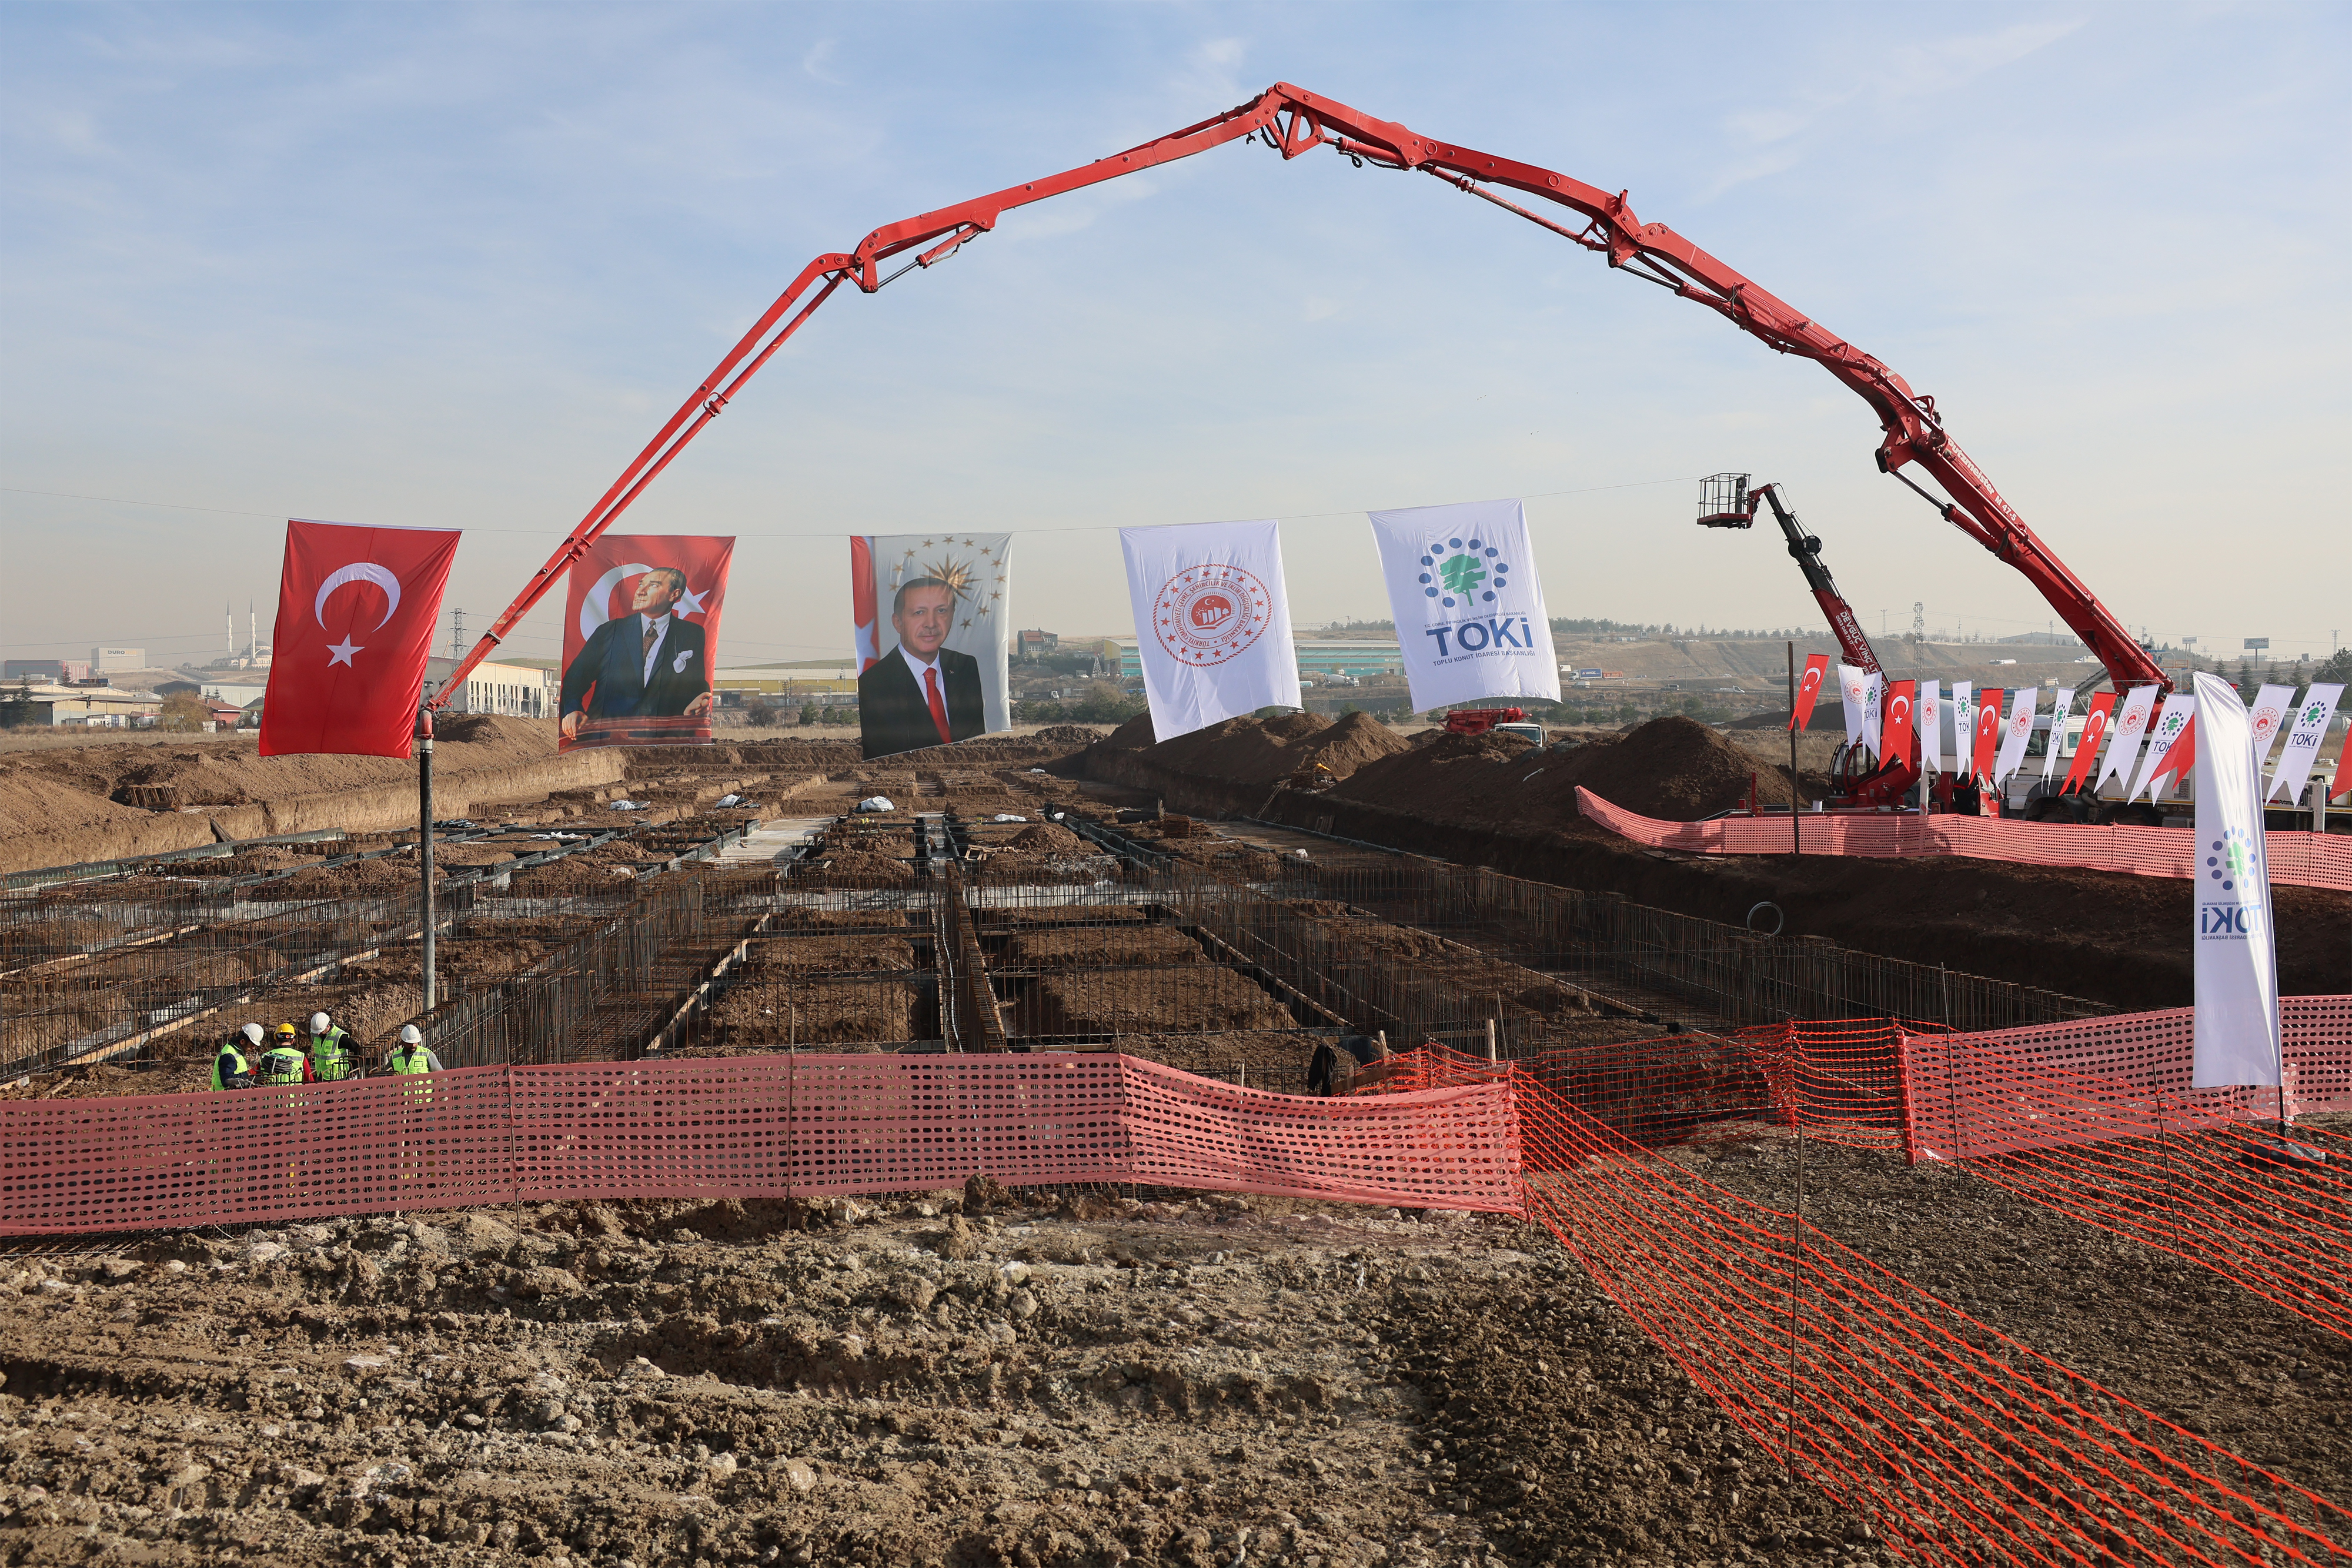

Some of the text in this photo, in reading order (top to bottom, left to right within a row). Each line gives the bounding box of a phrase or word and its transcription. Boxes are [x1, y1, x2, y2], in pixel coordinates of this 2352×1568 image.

[1948, 437, 1995, 494] Putzmeister
[1994, 495, 2003, 506] M
[1189, 580, 1220, 593] ŞEHİRCİLİK
[1227, 583, 1242, 594] İKLİM
[1238, 593, 1251, 621] DEĞİŞİKLİĞİ
[1174, 606, 1189, 640] CUMHURİYETİ
[1221, 620, 1245, 643] BAKANLIĞI
[1188, 638, 1210, 647] TÜRKİYE
[1433, 658, 1452, 666] TOPLU
[1454, 654, 1474, 662] KONUT
[1869, 664, 1879, 673] LT
